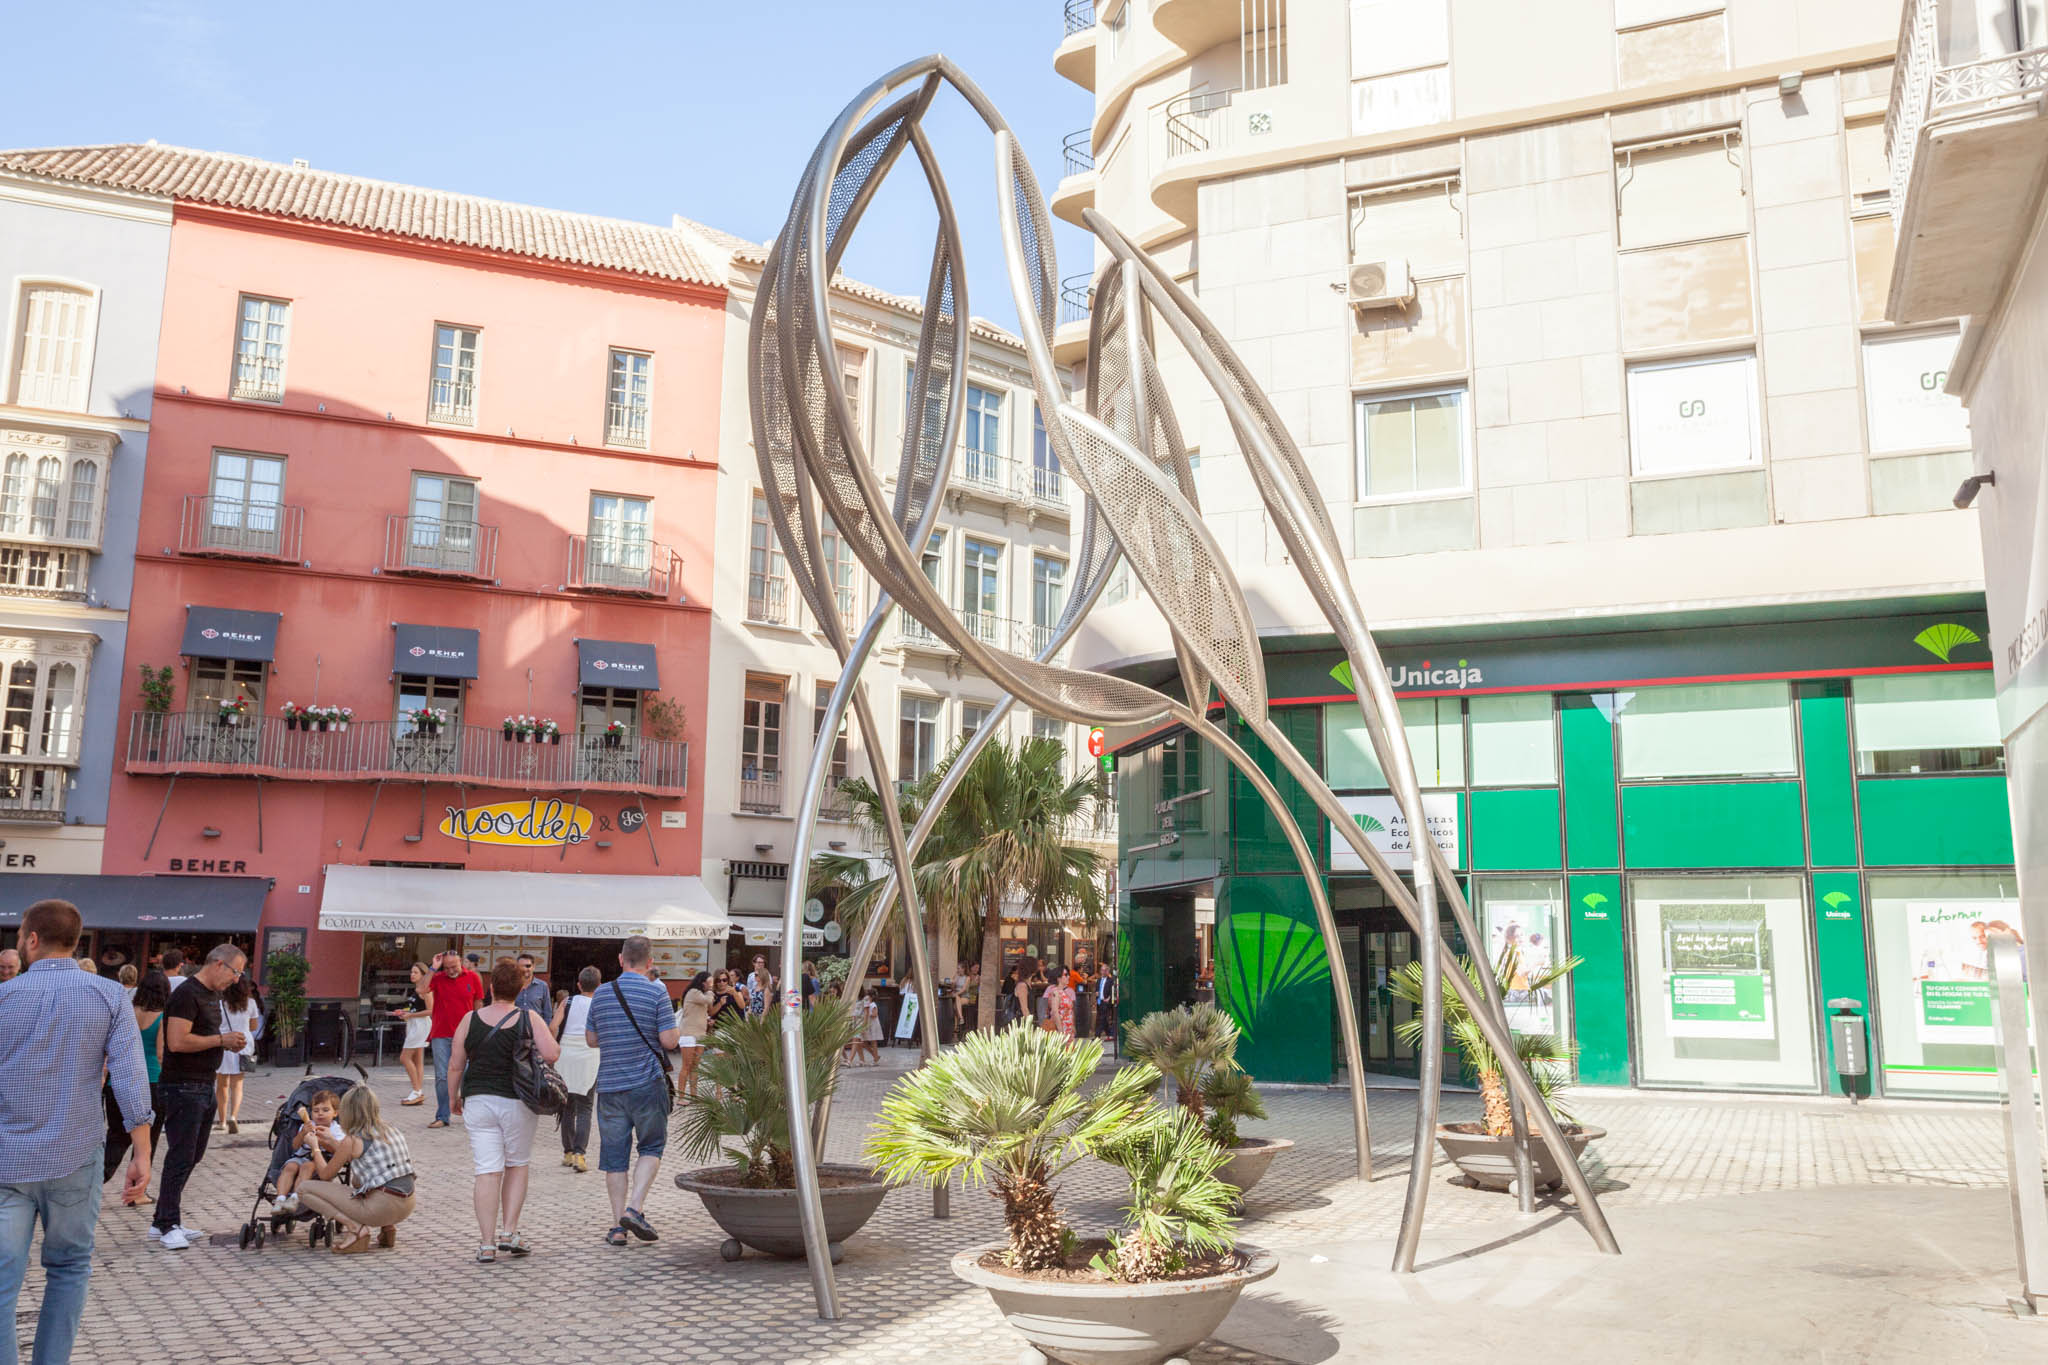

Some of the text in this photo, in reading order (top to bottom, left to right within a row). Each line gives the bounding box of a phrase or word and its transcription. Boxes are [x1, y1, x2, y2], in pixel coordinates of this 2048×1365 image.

[1386, 659, 1483, 689] Unicaja
[447, 797, 589, 843] noodles
[599, 815, 613, 832] &
[621, 808, 648, 826] go
[1391, 816, 1453, 825] Anstas
[1391, 828, 1454, 837] Ecoicos
[169, 859, 247, 873] BEHER
[325, 918, 724, 937] COMIDA SANA PIZZA HEALTHY FOOD TAKE AWAY
